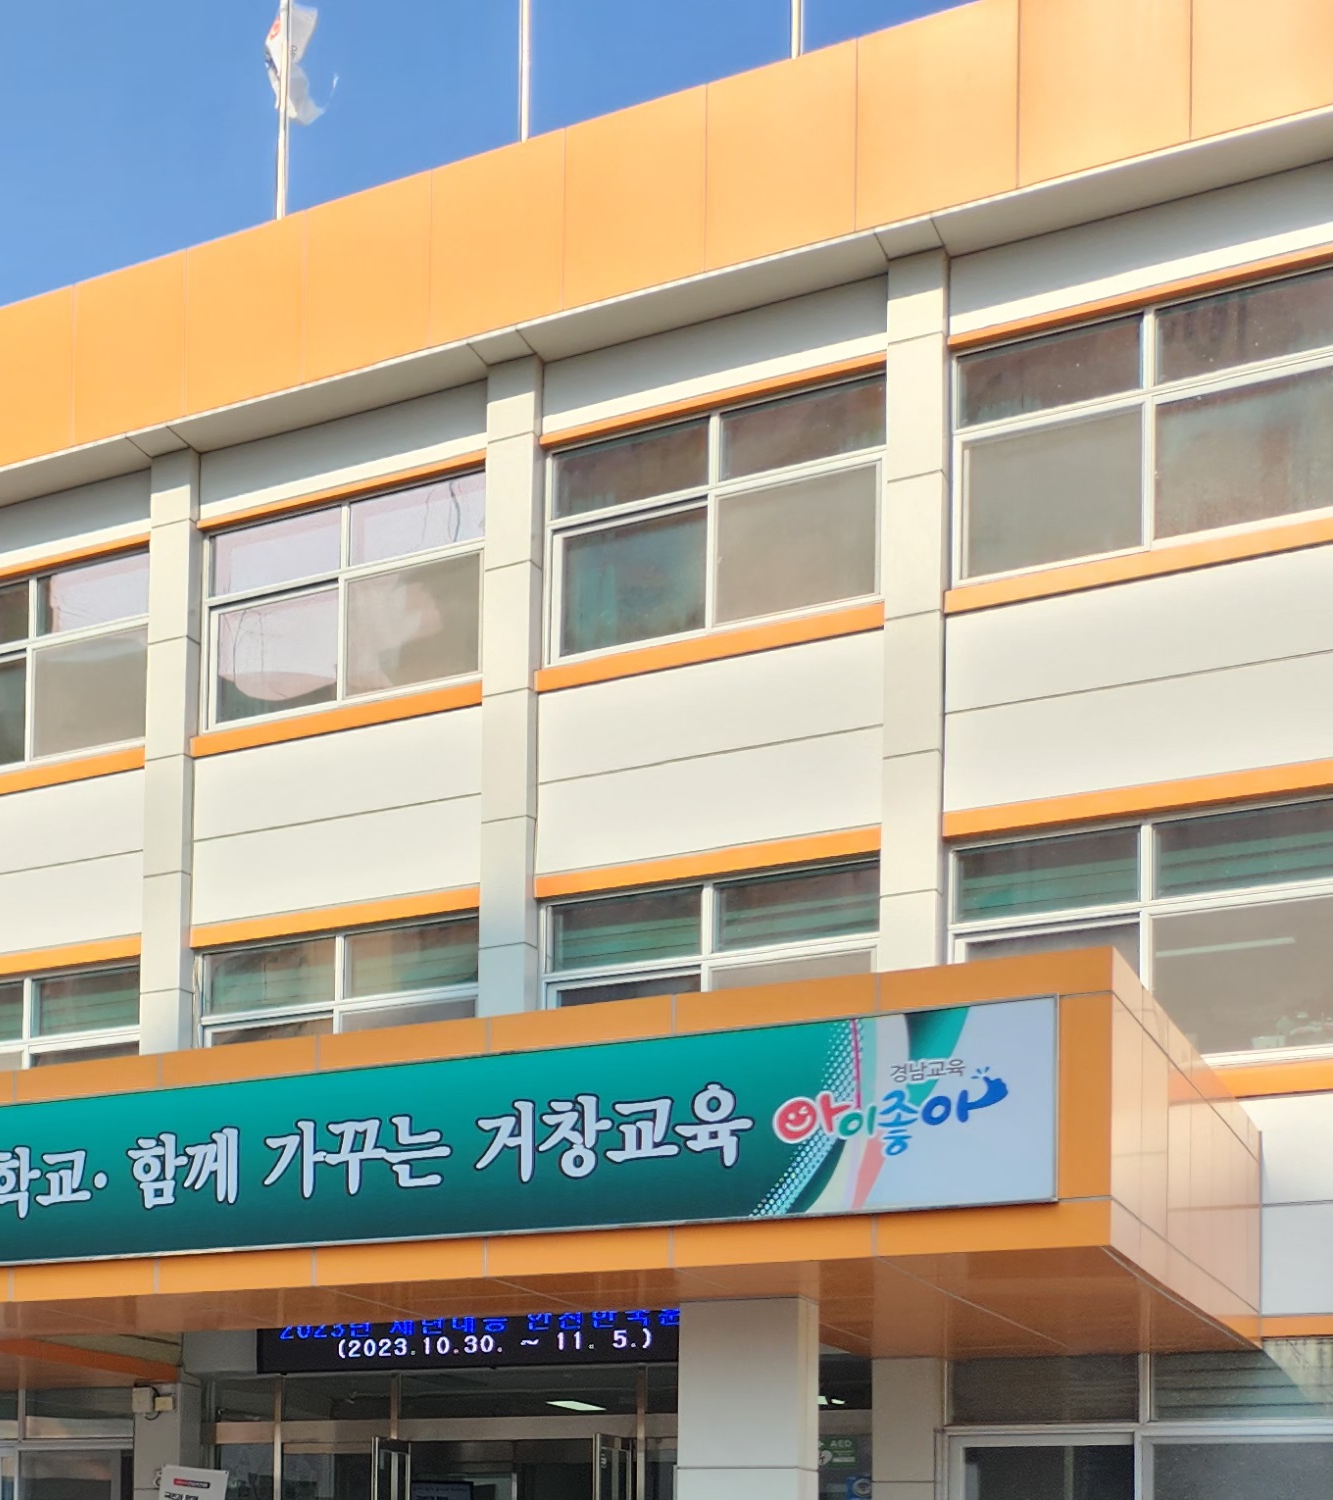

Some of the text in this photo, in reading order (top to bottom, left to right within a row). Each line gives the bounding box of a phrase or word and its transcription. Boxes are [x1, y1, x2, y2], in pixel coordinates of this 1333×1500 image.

[890, 1058, 965, 1083] 경남교육
[127, 1126, 240, 1209] 함께
[264, 1113, 452, 1199] 가꾸는
[475, 1083, 753, 1184] 거창교육
[773, 1076, 1009, 1157] 아이좋아
